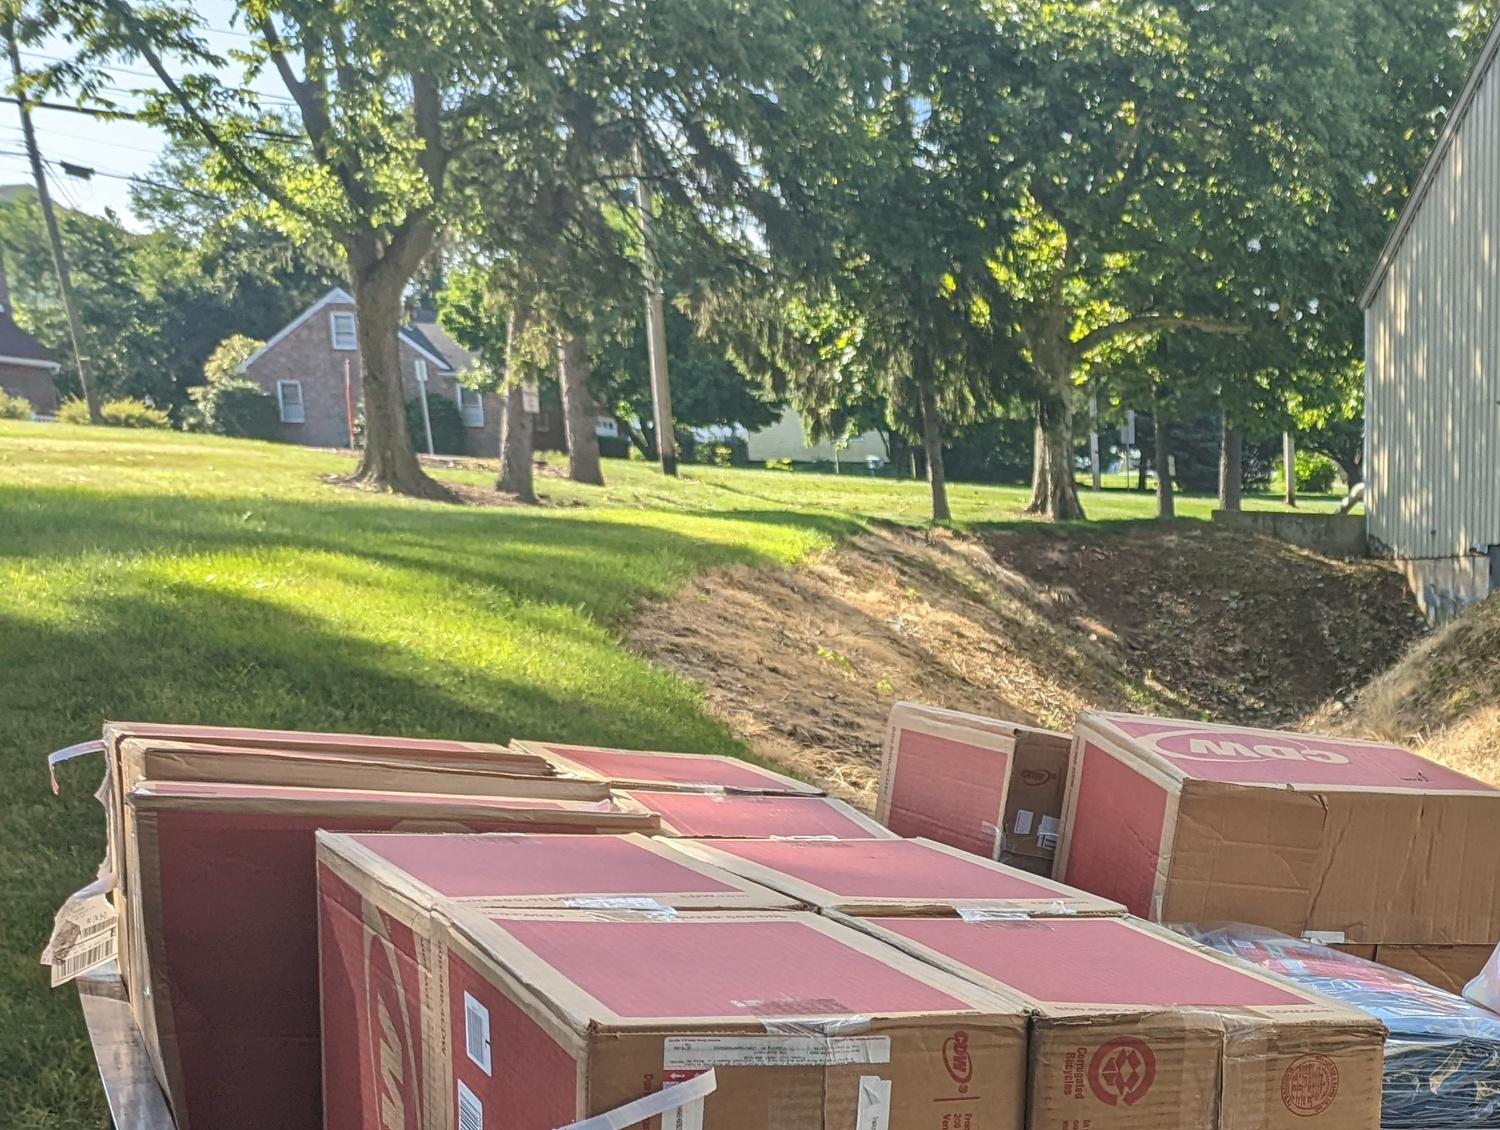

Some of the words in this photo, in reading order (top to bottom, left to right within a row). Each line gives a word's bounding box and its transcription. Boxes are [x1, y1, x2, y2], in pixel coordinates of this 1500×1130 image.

[1189, 738, 1351, 765] CDW
[1063, 1052, 1076, 1095] Recycles
[1074, 1047, 1088, 1099] Corrugated
